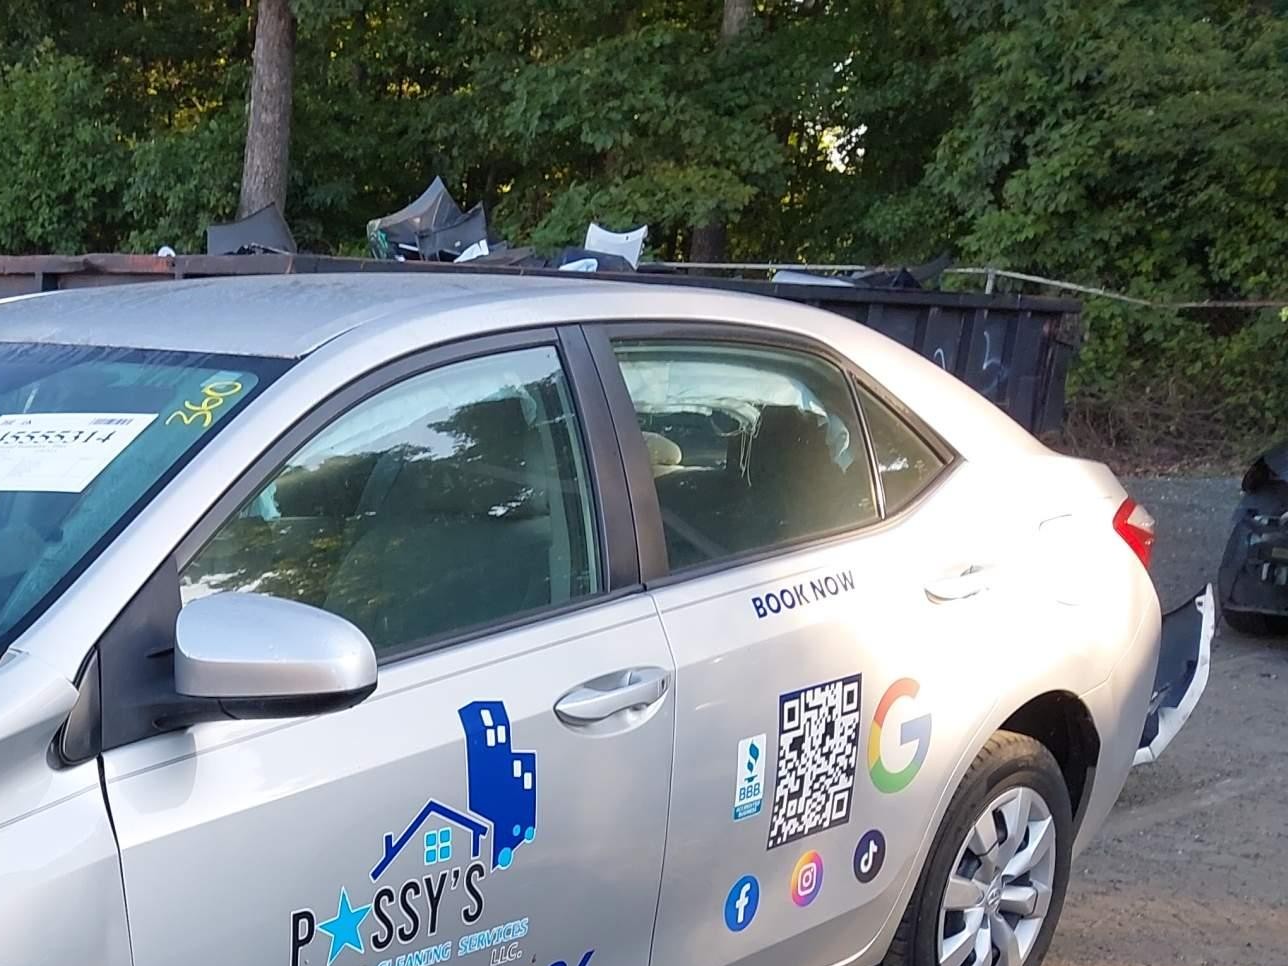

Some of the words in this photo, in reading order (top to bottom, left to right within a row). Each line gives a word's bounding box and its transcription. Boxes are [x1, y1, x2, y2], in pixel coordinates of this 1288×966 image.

[165, 381, 242, 427] 360
[752, 583, 811, 619] BOOK
[809, 570, 855, 601] NOW
[868, 677, 932, 794] G
[738, 783, 761, 802] BBB
[458, 917, 529, 956] SERVICES
[490, 942, 523, 966] LLC.
